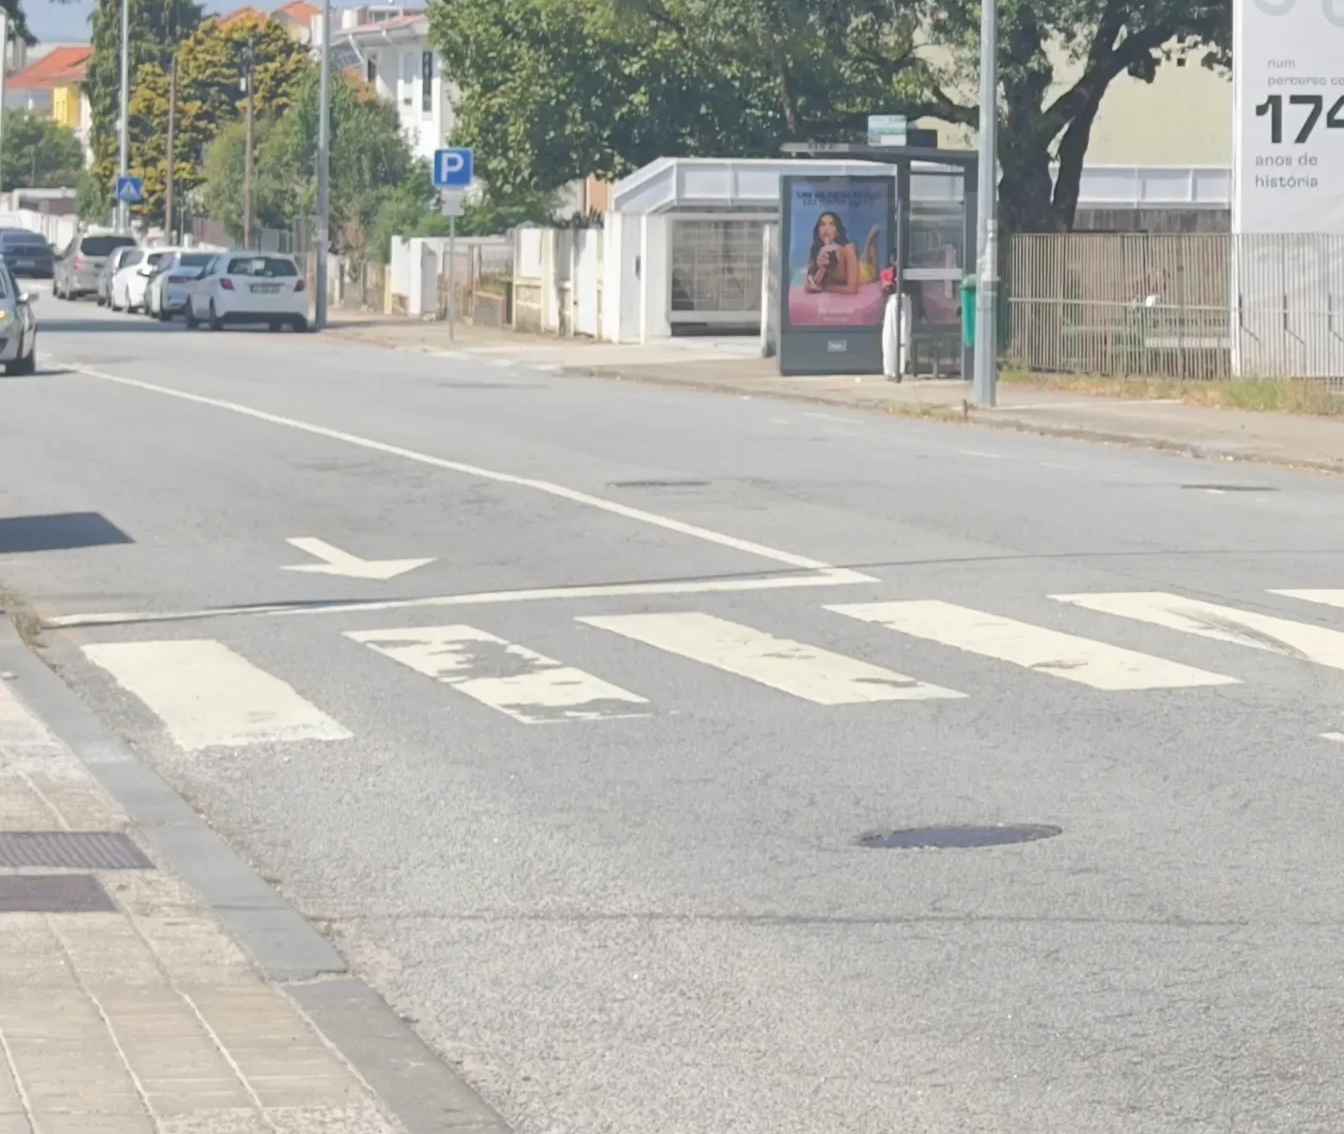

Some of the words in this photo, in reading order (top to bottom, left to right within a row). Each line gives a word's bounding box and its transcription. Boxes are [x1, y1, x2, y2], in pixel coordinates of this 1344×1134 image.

[1267, 59, 1296, 69] num
[1267, 76, 1327, 86] percurso
[1255, 155, 1293, 167] anos
[1298, 152, 1318, 167] de
[441, 152, 465, 183] P
[1255, 174, 1319, 188] história
